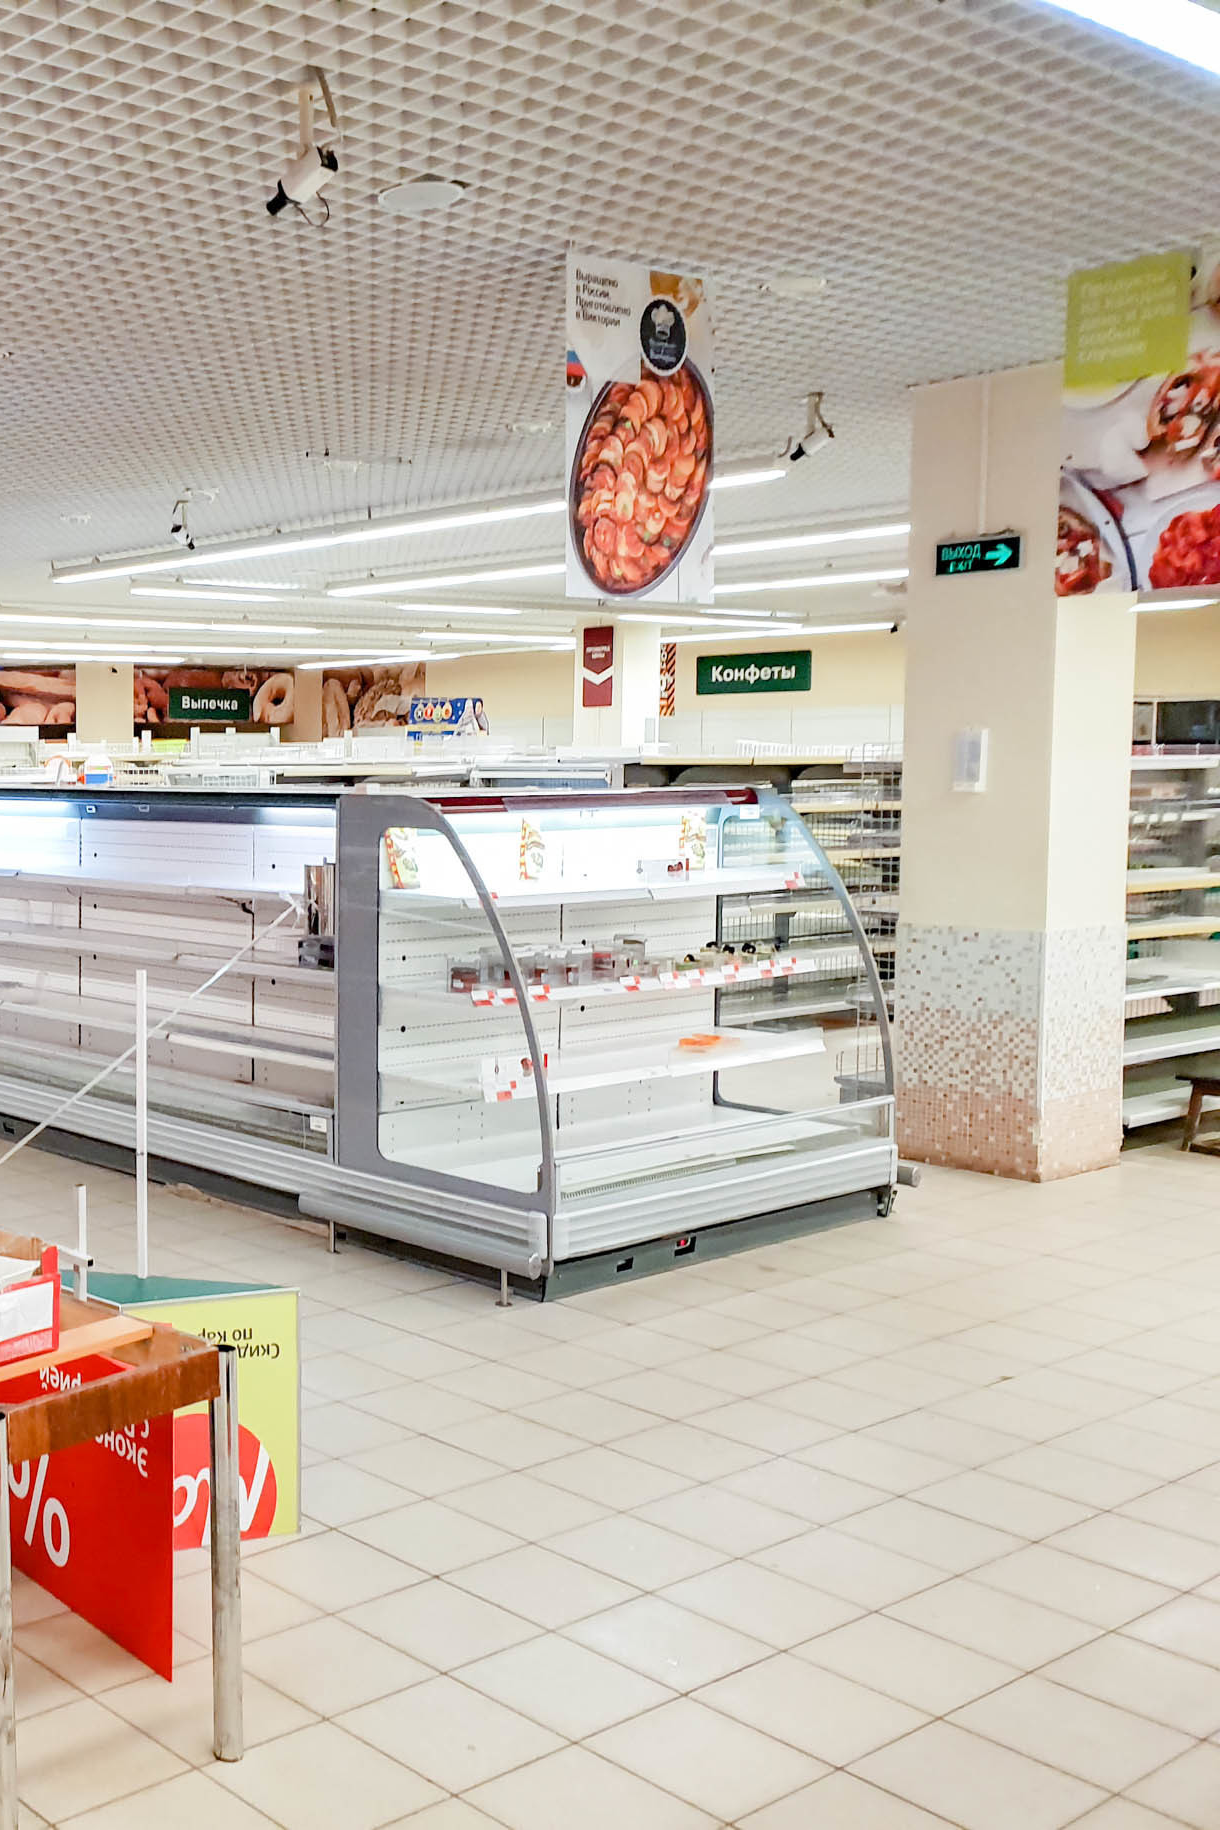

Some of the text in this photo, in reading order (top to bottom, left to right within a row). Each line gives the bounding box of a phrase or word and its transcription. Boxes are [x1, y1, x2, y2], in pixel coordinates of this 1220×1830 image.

[941, 543, 981, 561] ВЫХОД
[711, 663, 797, 685] Конфеты
[181, 695, 239, 711] Выпечка
